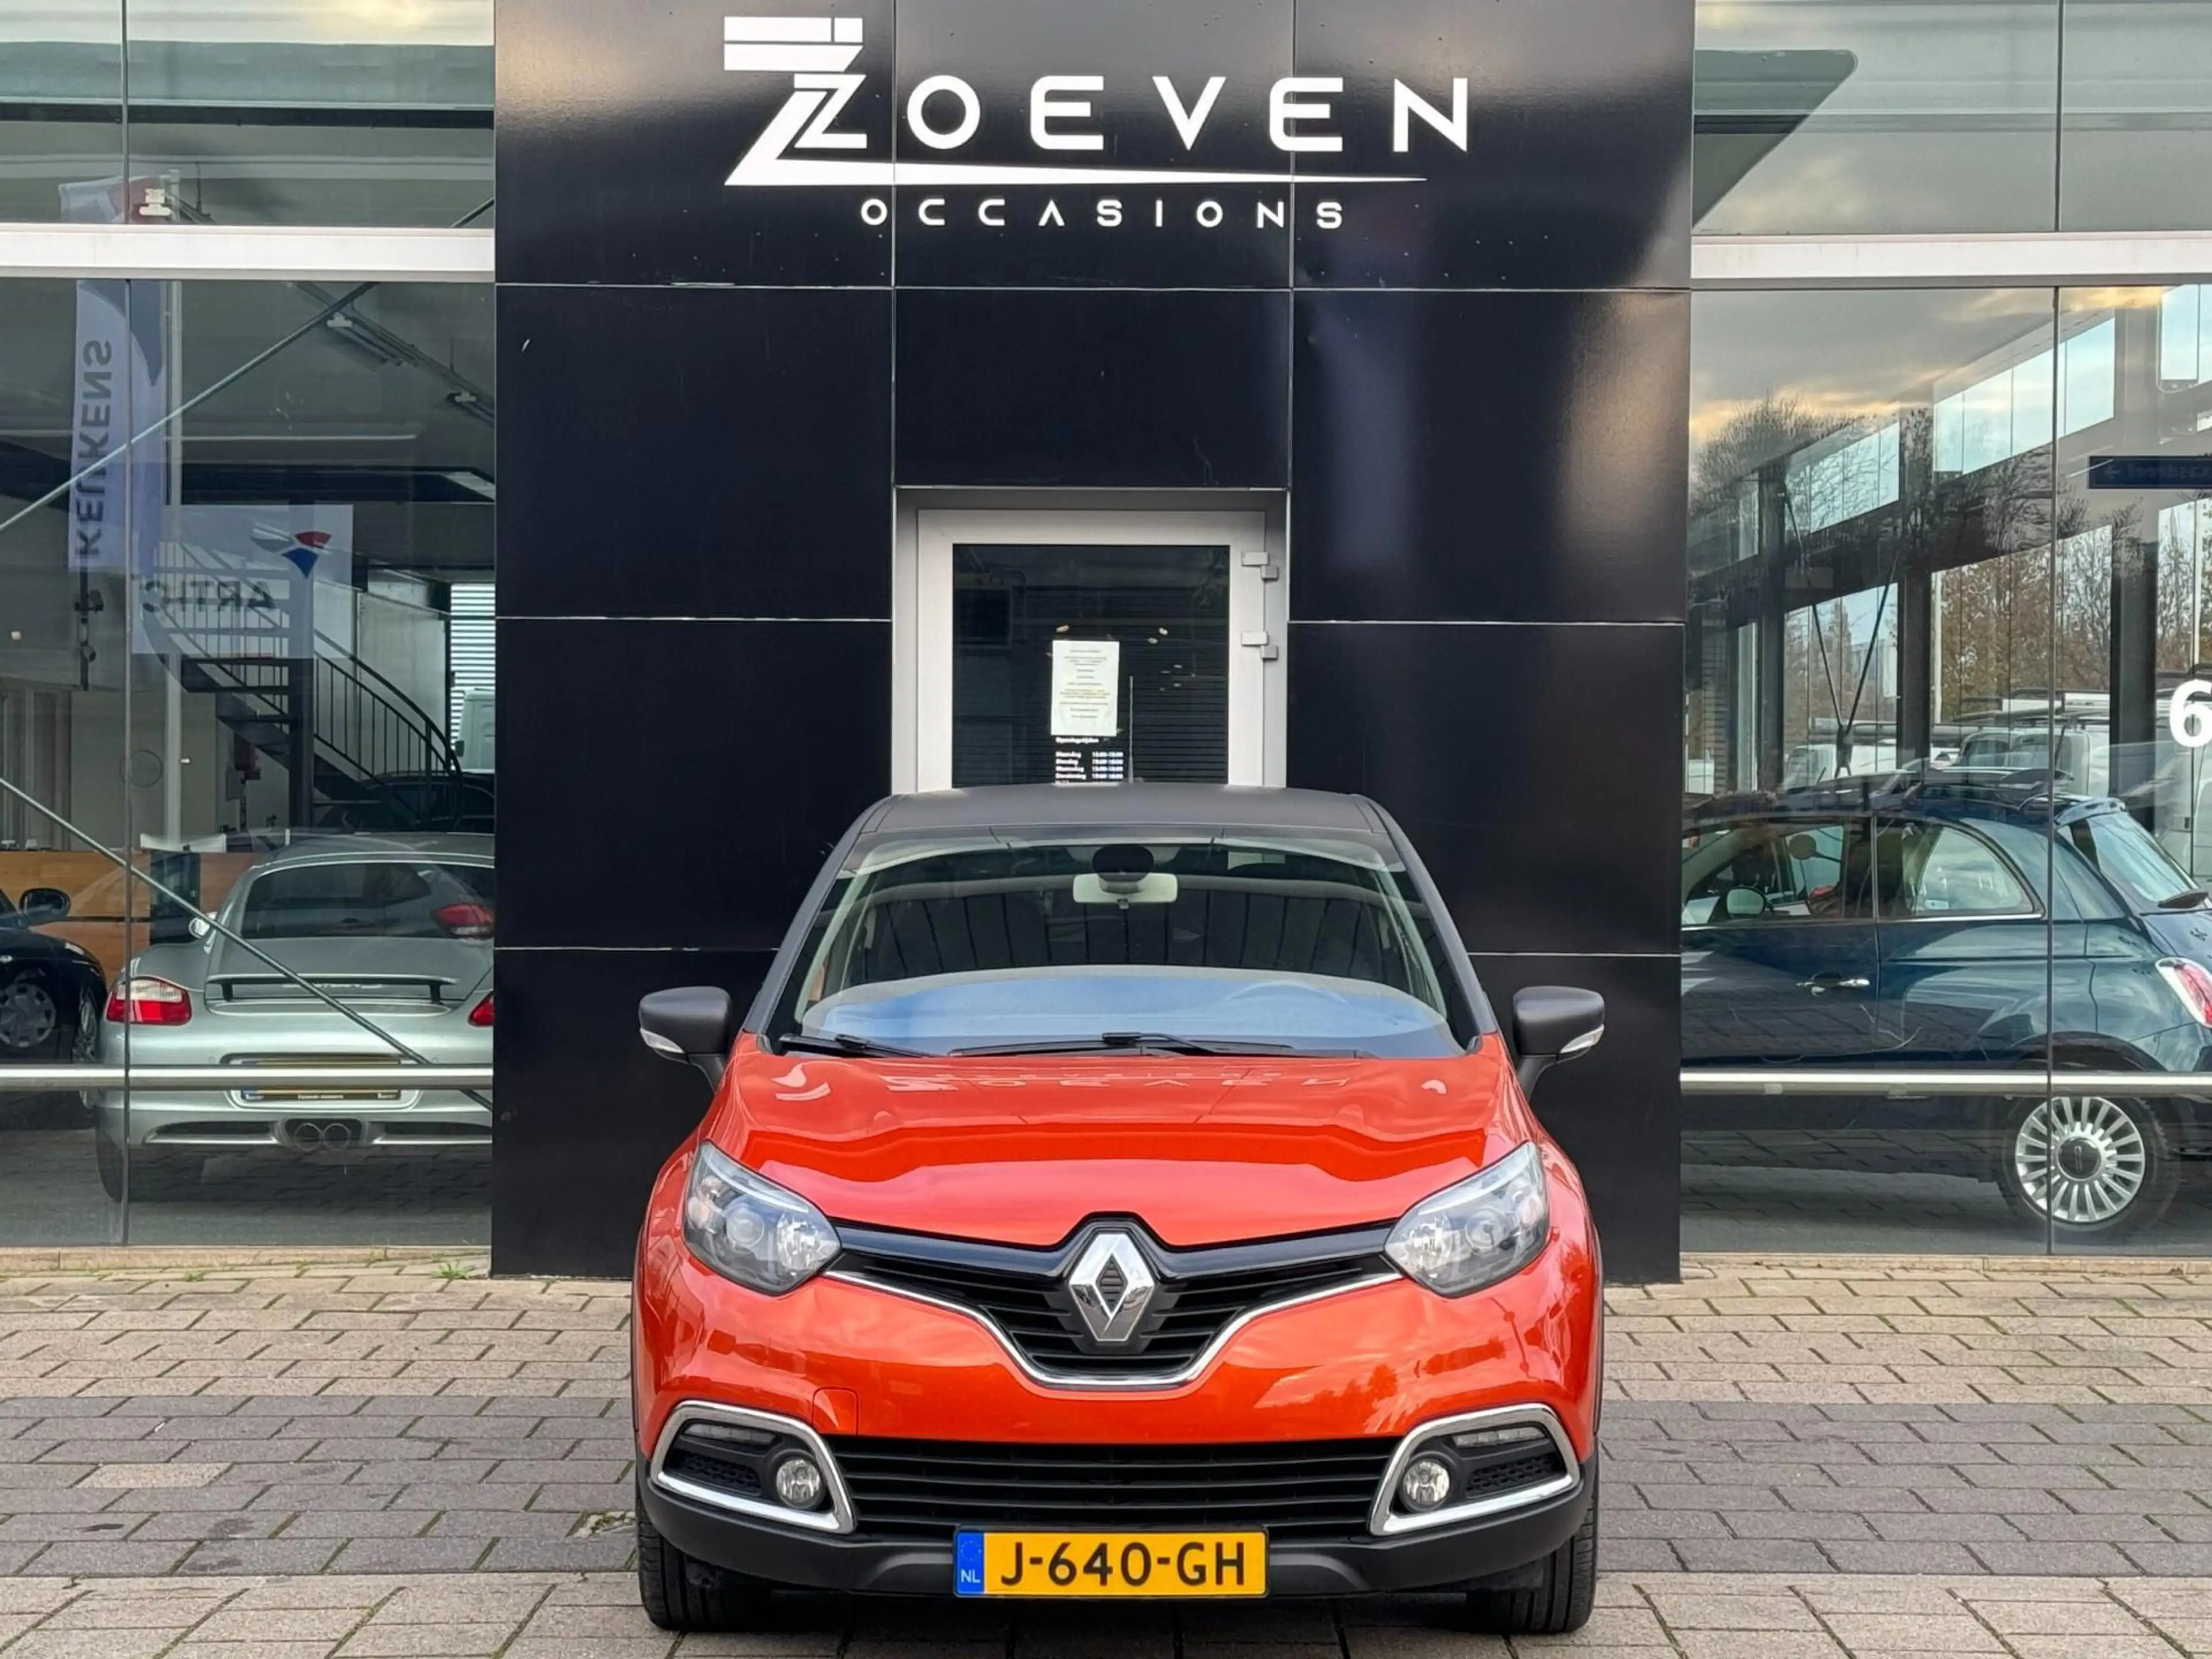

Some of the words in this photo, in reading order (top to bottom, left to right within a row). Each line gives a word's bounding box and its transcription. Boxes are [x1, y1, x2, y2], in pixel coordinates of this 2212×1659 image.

[724, 16, 1468, 186] ZOEVEN
[861, 198, 1343, 228] OCCASIONS
[961, 1568, 981, 1583] NL
[1001, 1541, 1244, 1586] J-640-GH
